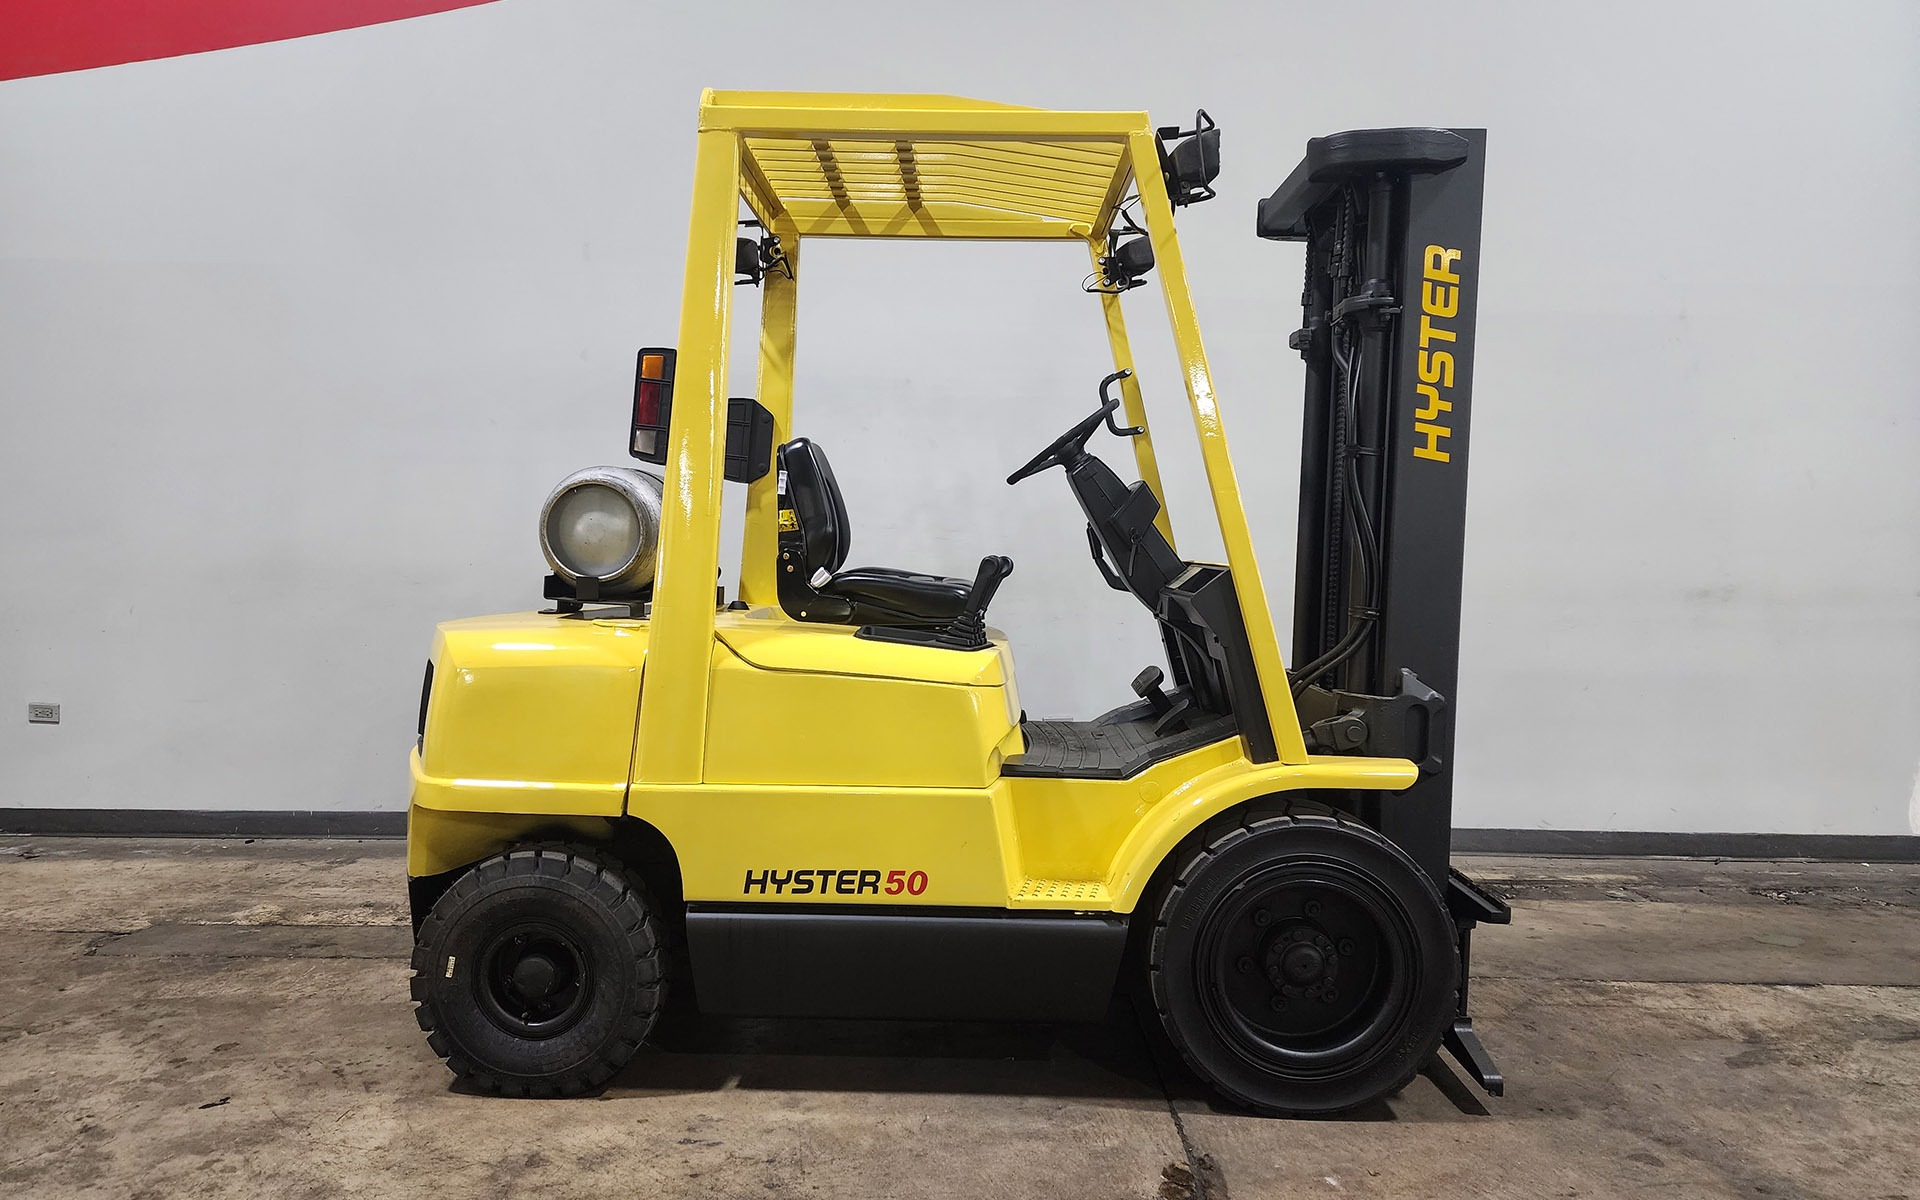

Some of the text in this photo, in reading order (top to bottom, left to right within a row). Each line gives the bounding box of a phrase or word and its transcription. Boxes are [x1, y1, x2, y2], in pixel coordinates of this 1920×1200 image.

[1413, 244, 1462, 463] HYSTER
[743, 869, 929, 896] HYSTER 50
